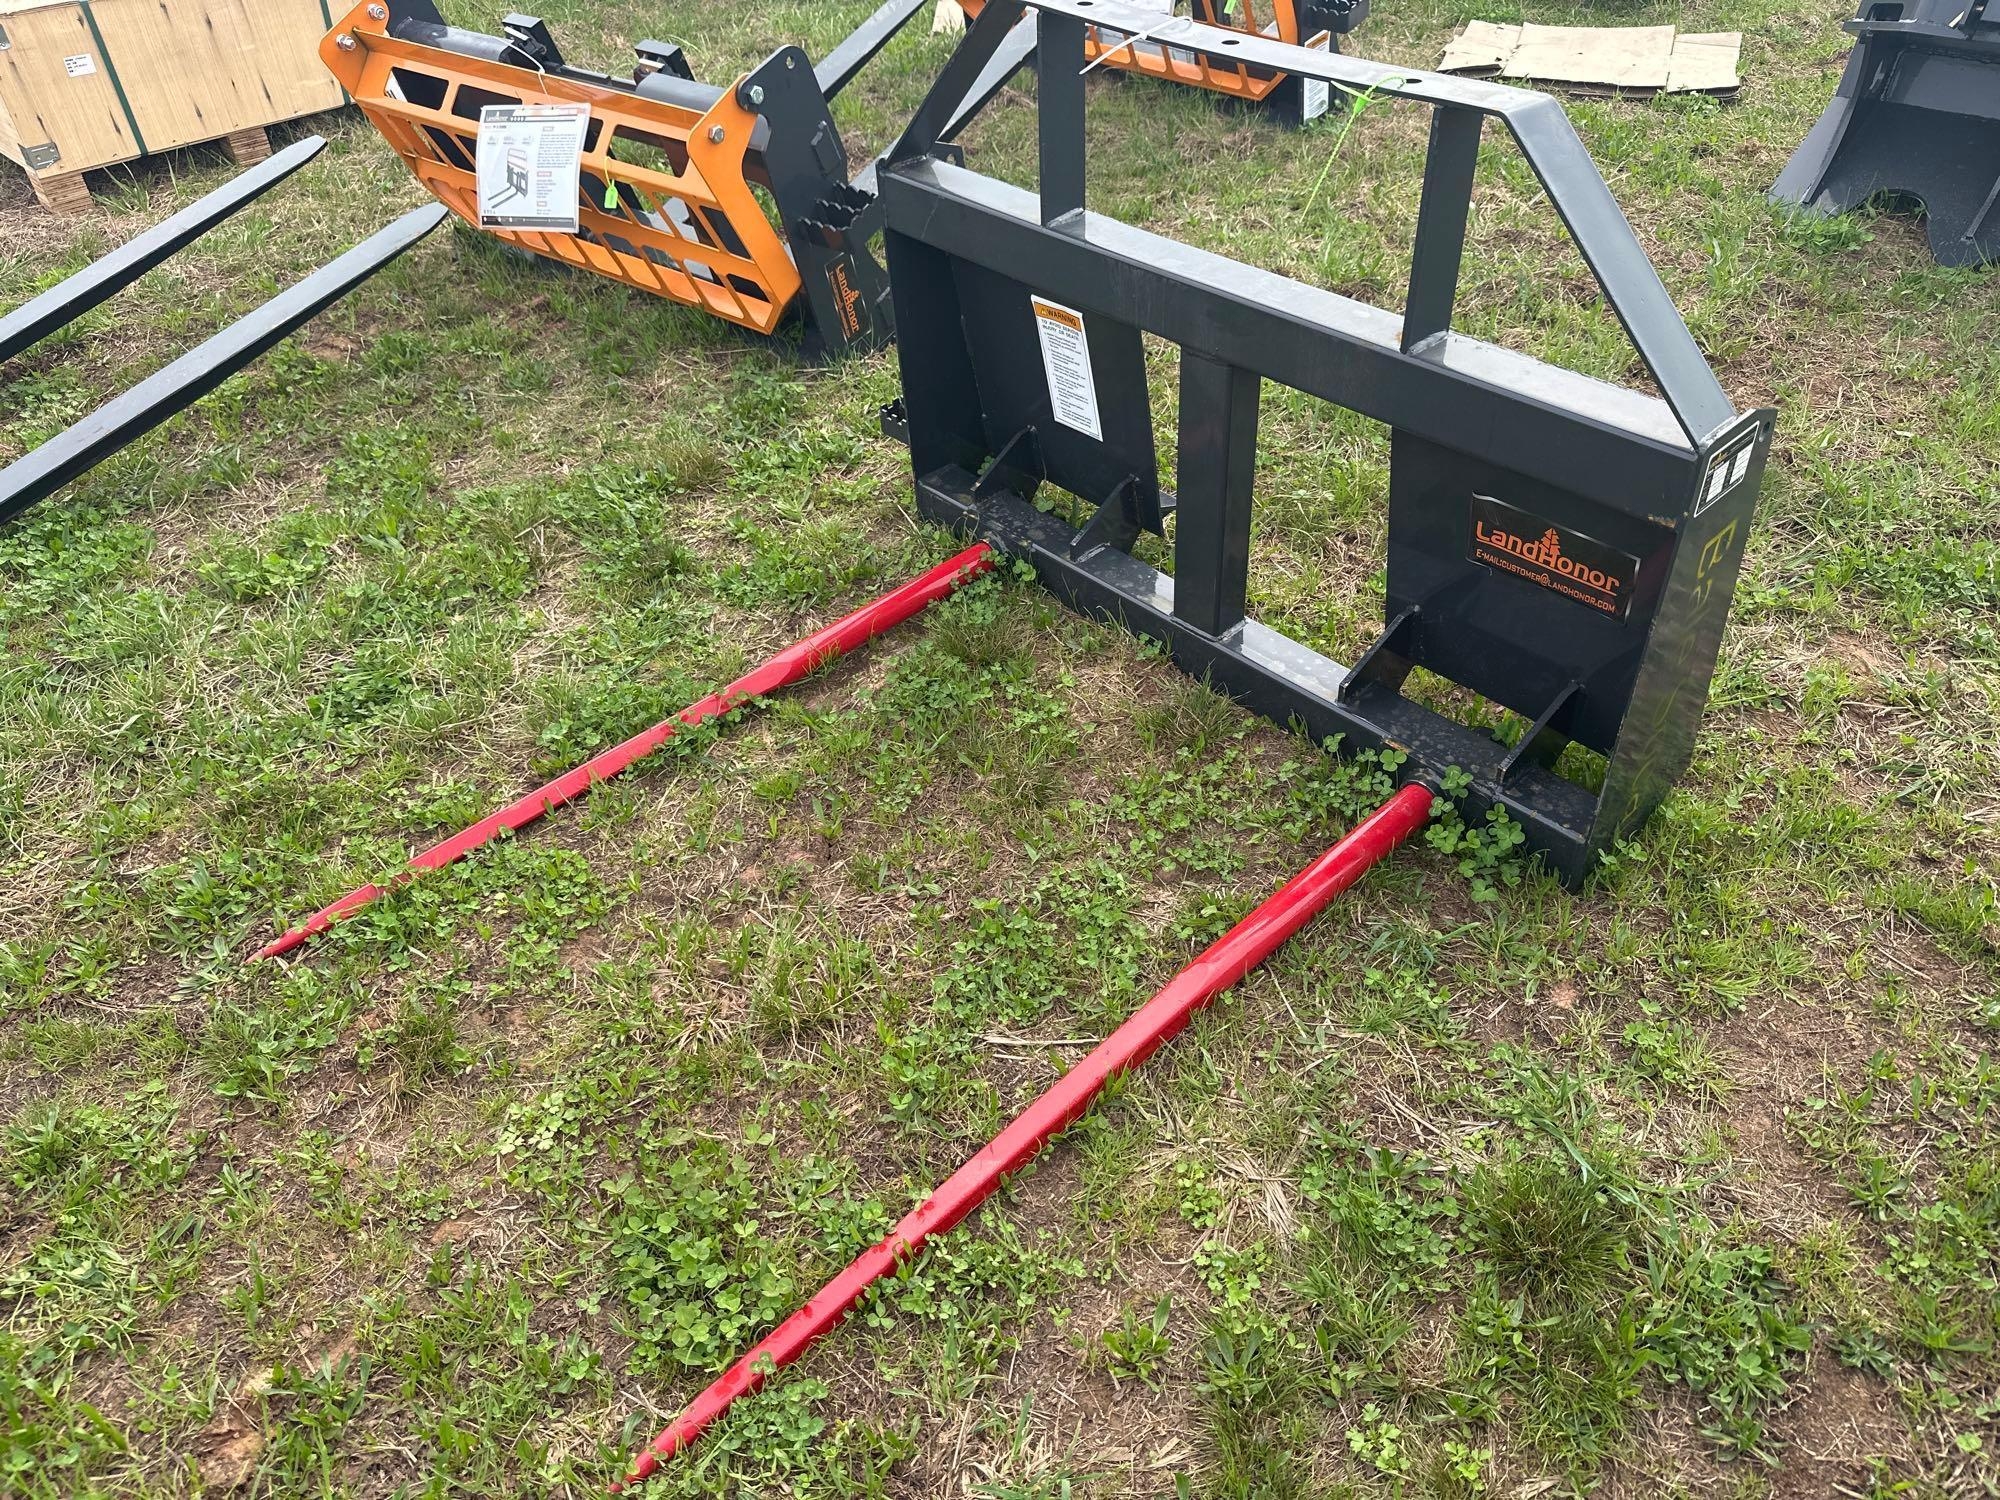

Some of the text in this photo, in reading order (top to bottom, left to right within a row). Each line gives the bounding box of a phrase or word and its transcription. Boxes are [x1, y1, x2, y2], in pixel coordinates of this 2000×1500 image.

[1047, 308, 1077, 327] WARNING
[1475, 548, 1617, 614] E-MAIL:CUSTOMER@LANDHONOR.COM
[1476, 520, 1620, 592] LandHonor
